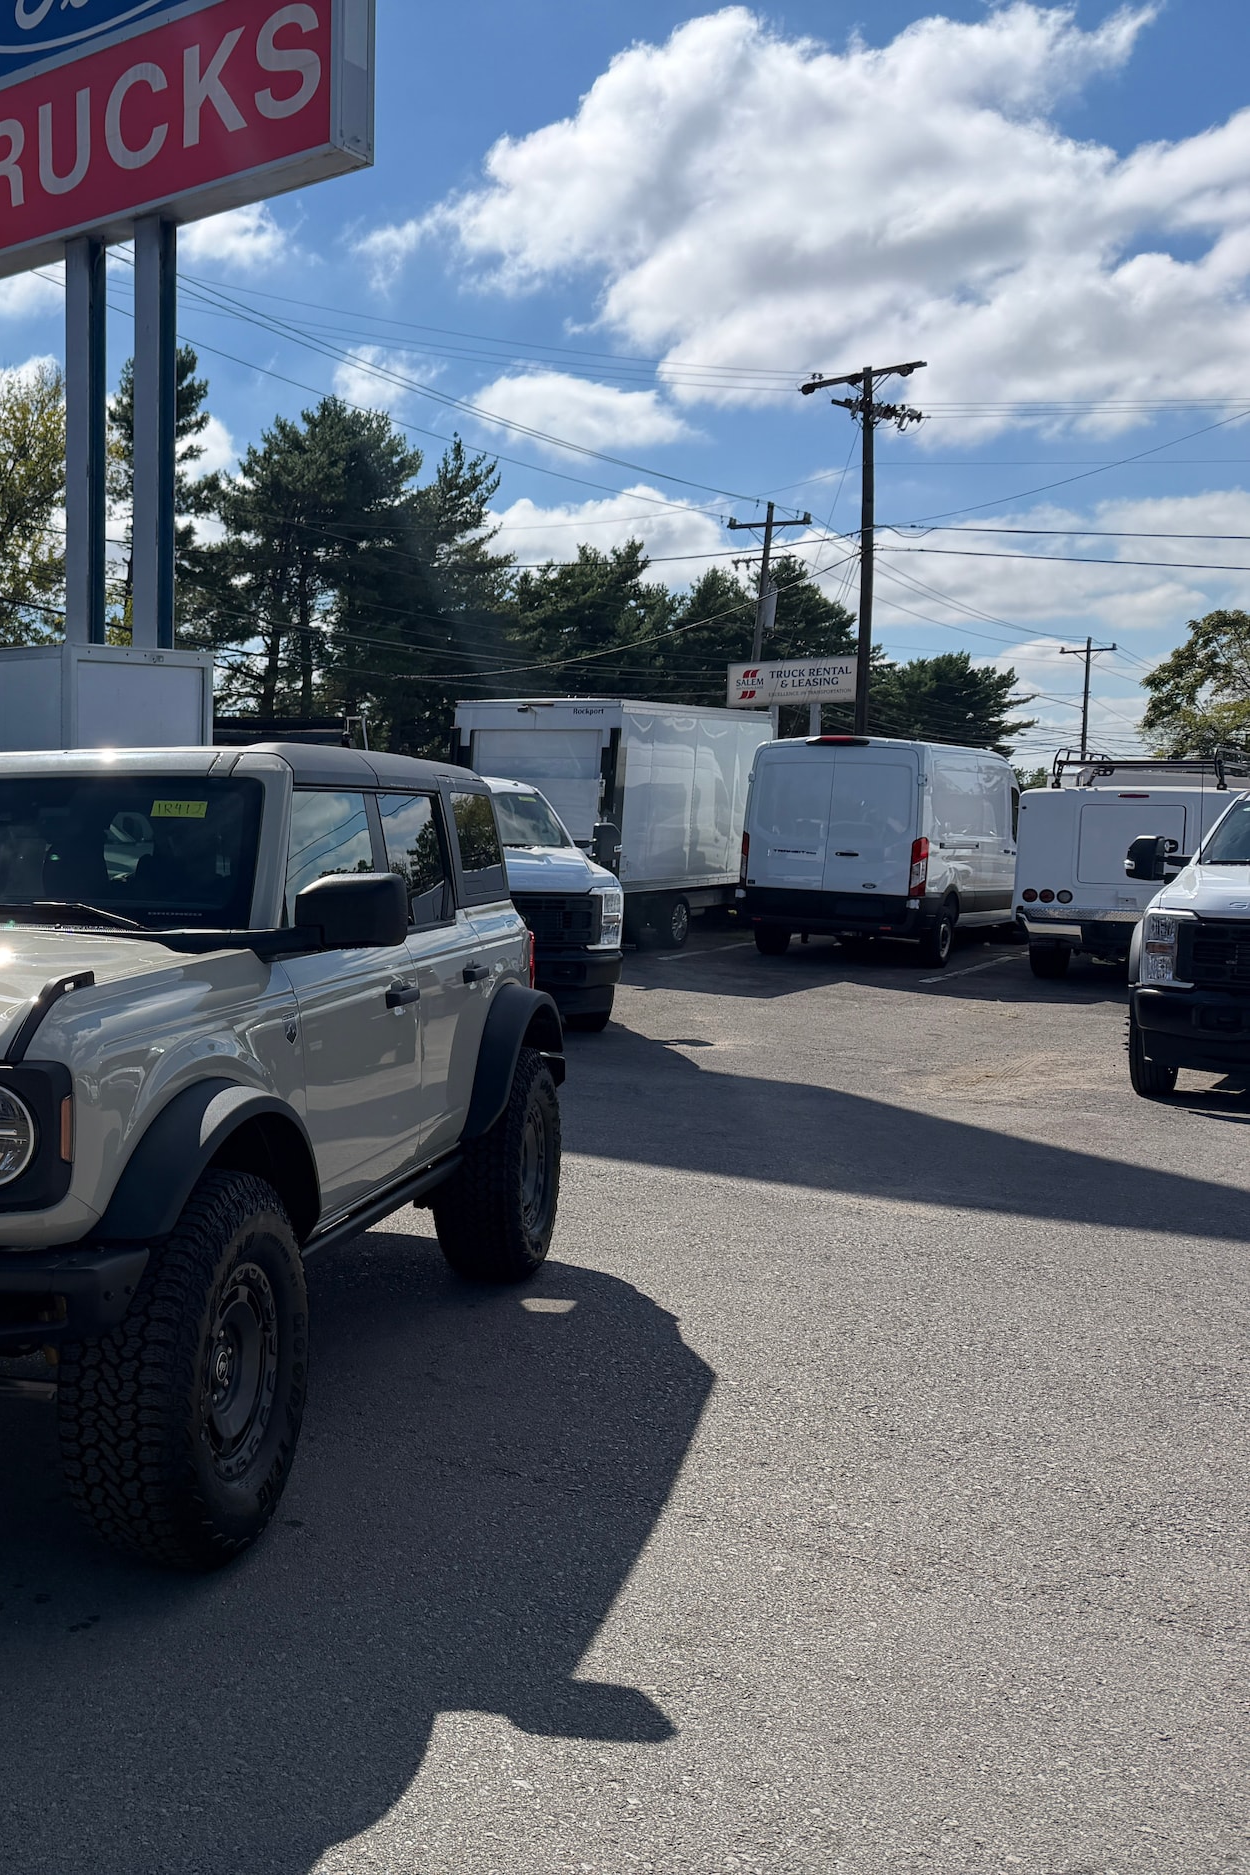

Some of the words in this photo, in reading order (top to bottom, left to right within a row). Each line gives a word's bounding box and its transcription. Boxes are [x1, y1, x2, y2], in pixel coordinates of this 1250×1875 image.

[769, 668, 806, 679] TRUCK
[809, 666, 852, 677] RENTAL
[736, 678, 764, 687] SALEM
[780, 679, 789, 688] &
[792, 677, 839, 688] LEASING
[573, 708, 604, 716] Rockport
